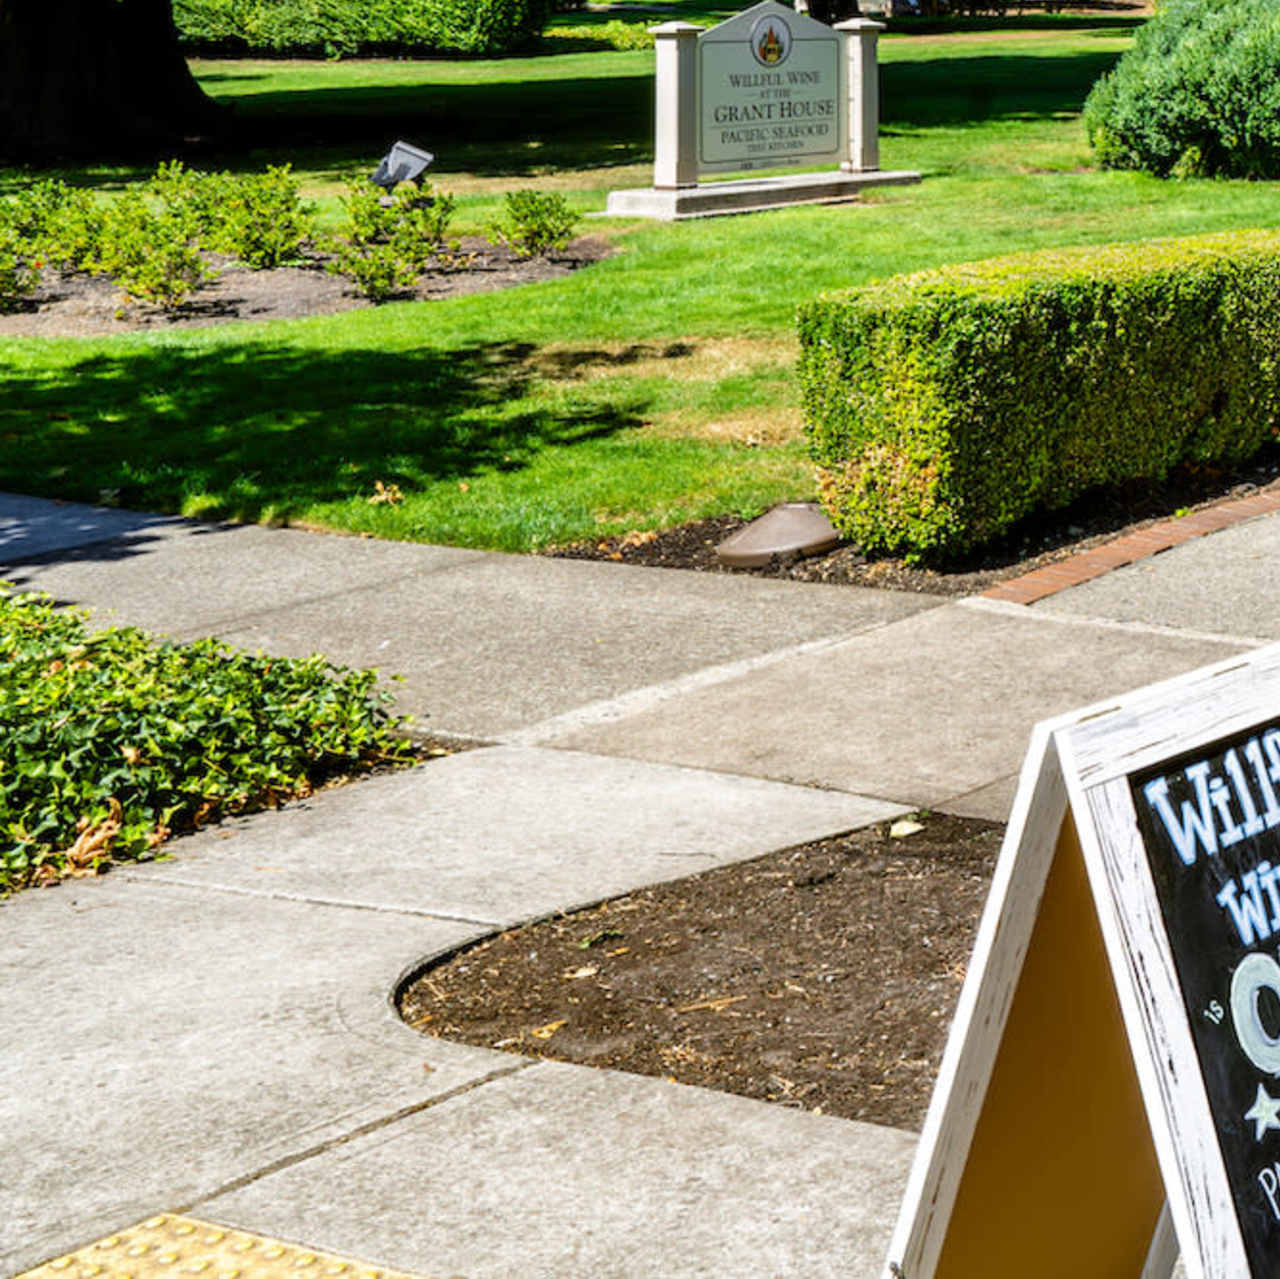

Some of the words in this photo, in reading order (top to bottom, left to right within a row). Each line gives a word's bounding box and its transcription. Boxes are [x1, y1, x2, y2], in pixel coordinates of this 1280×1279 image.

[729, 73, 784, 88] WILLFUL
[787, 71, 821, 85] WINE
[713, 103, 777, 123] GRANT
[779, 99, 834, 118] HOUSE
[721, 128, 769, 144] PACIFIC
[772, 124, 829, 139] SEAFOOD
